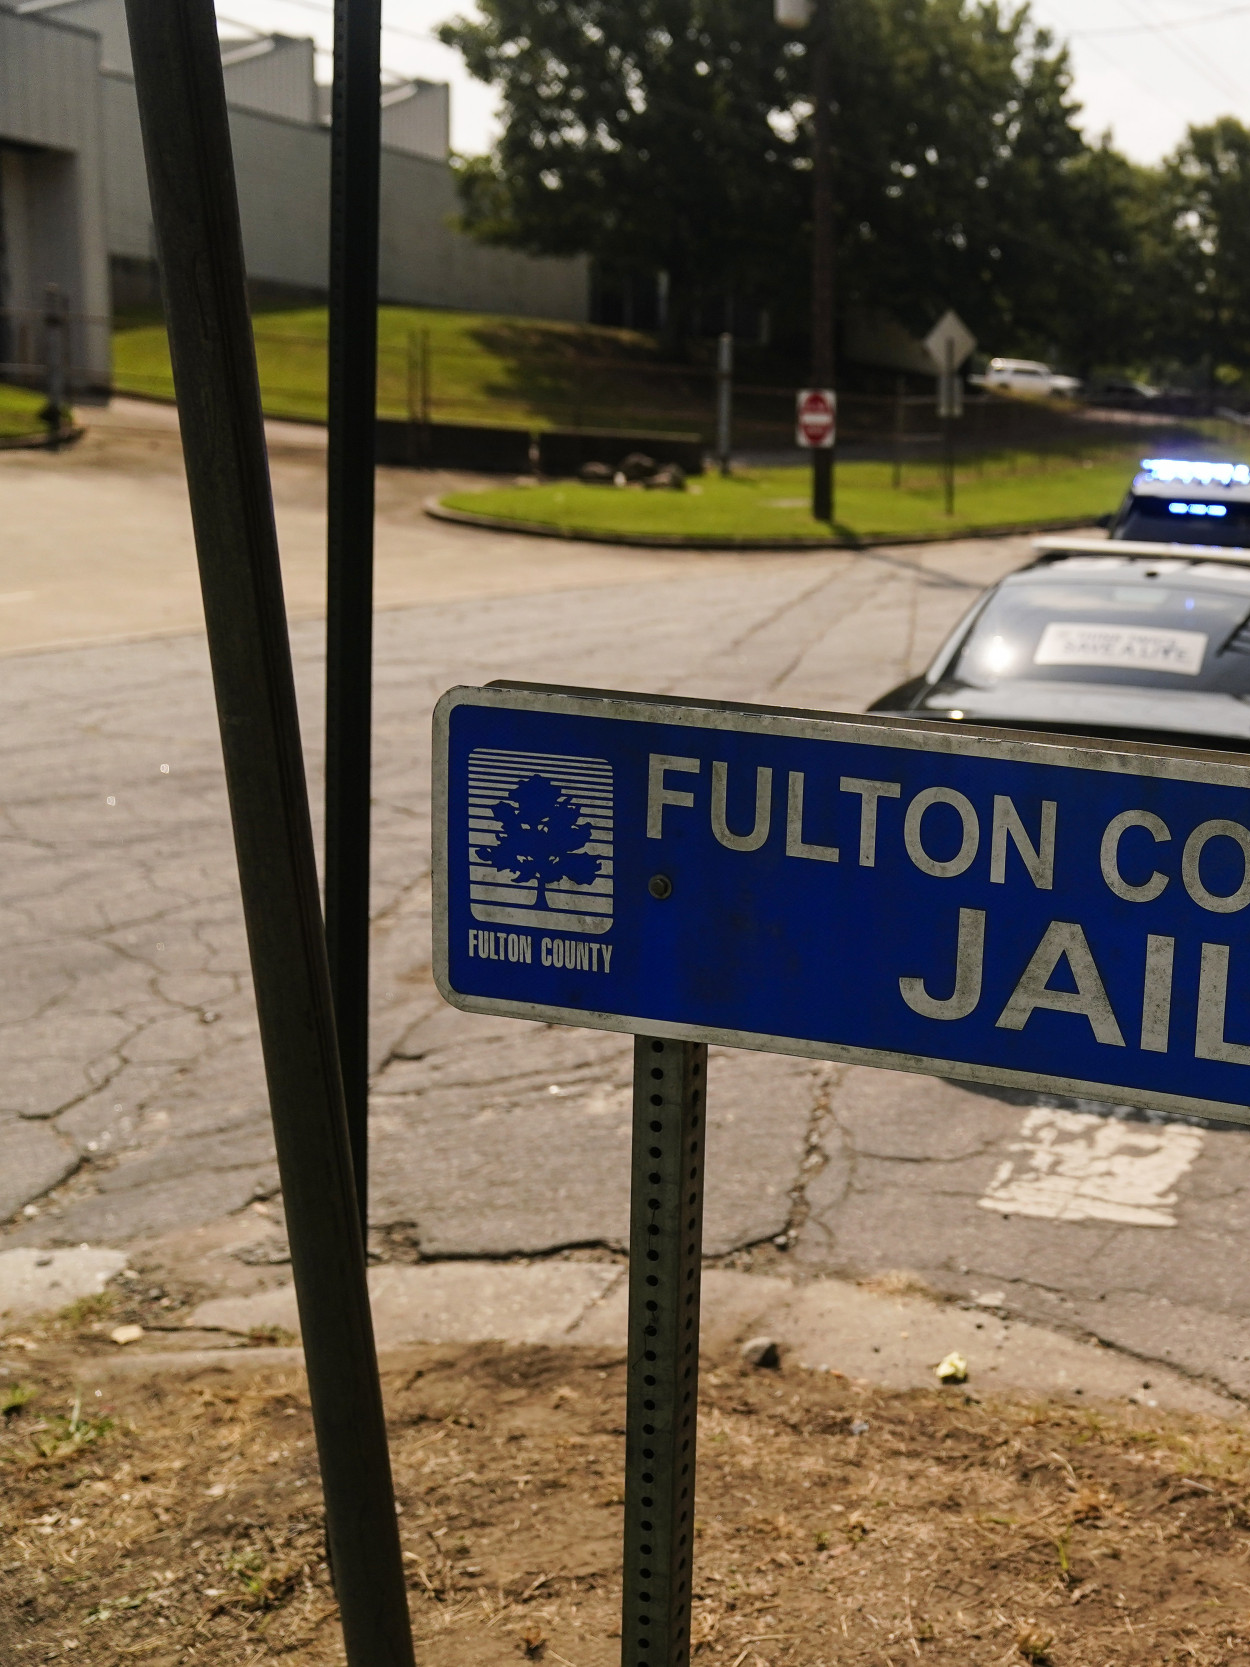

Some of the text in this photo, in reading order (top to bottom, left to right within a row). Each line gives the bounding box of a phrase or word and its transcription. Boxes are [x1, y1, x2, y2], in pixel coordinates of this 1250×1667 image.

[646, 753, 1058, 890] FULTON
[468, 929, 614, 974] FULTON COUNTY
